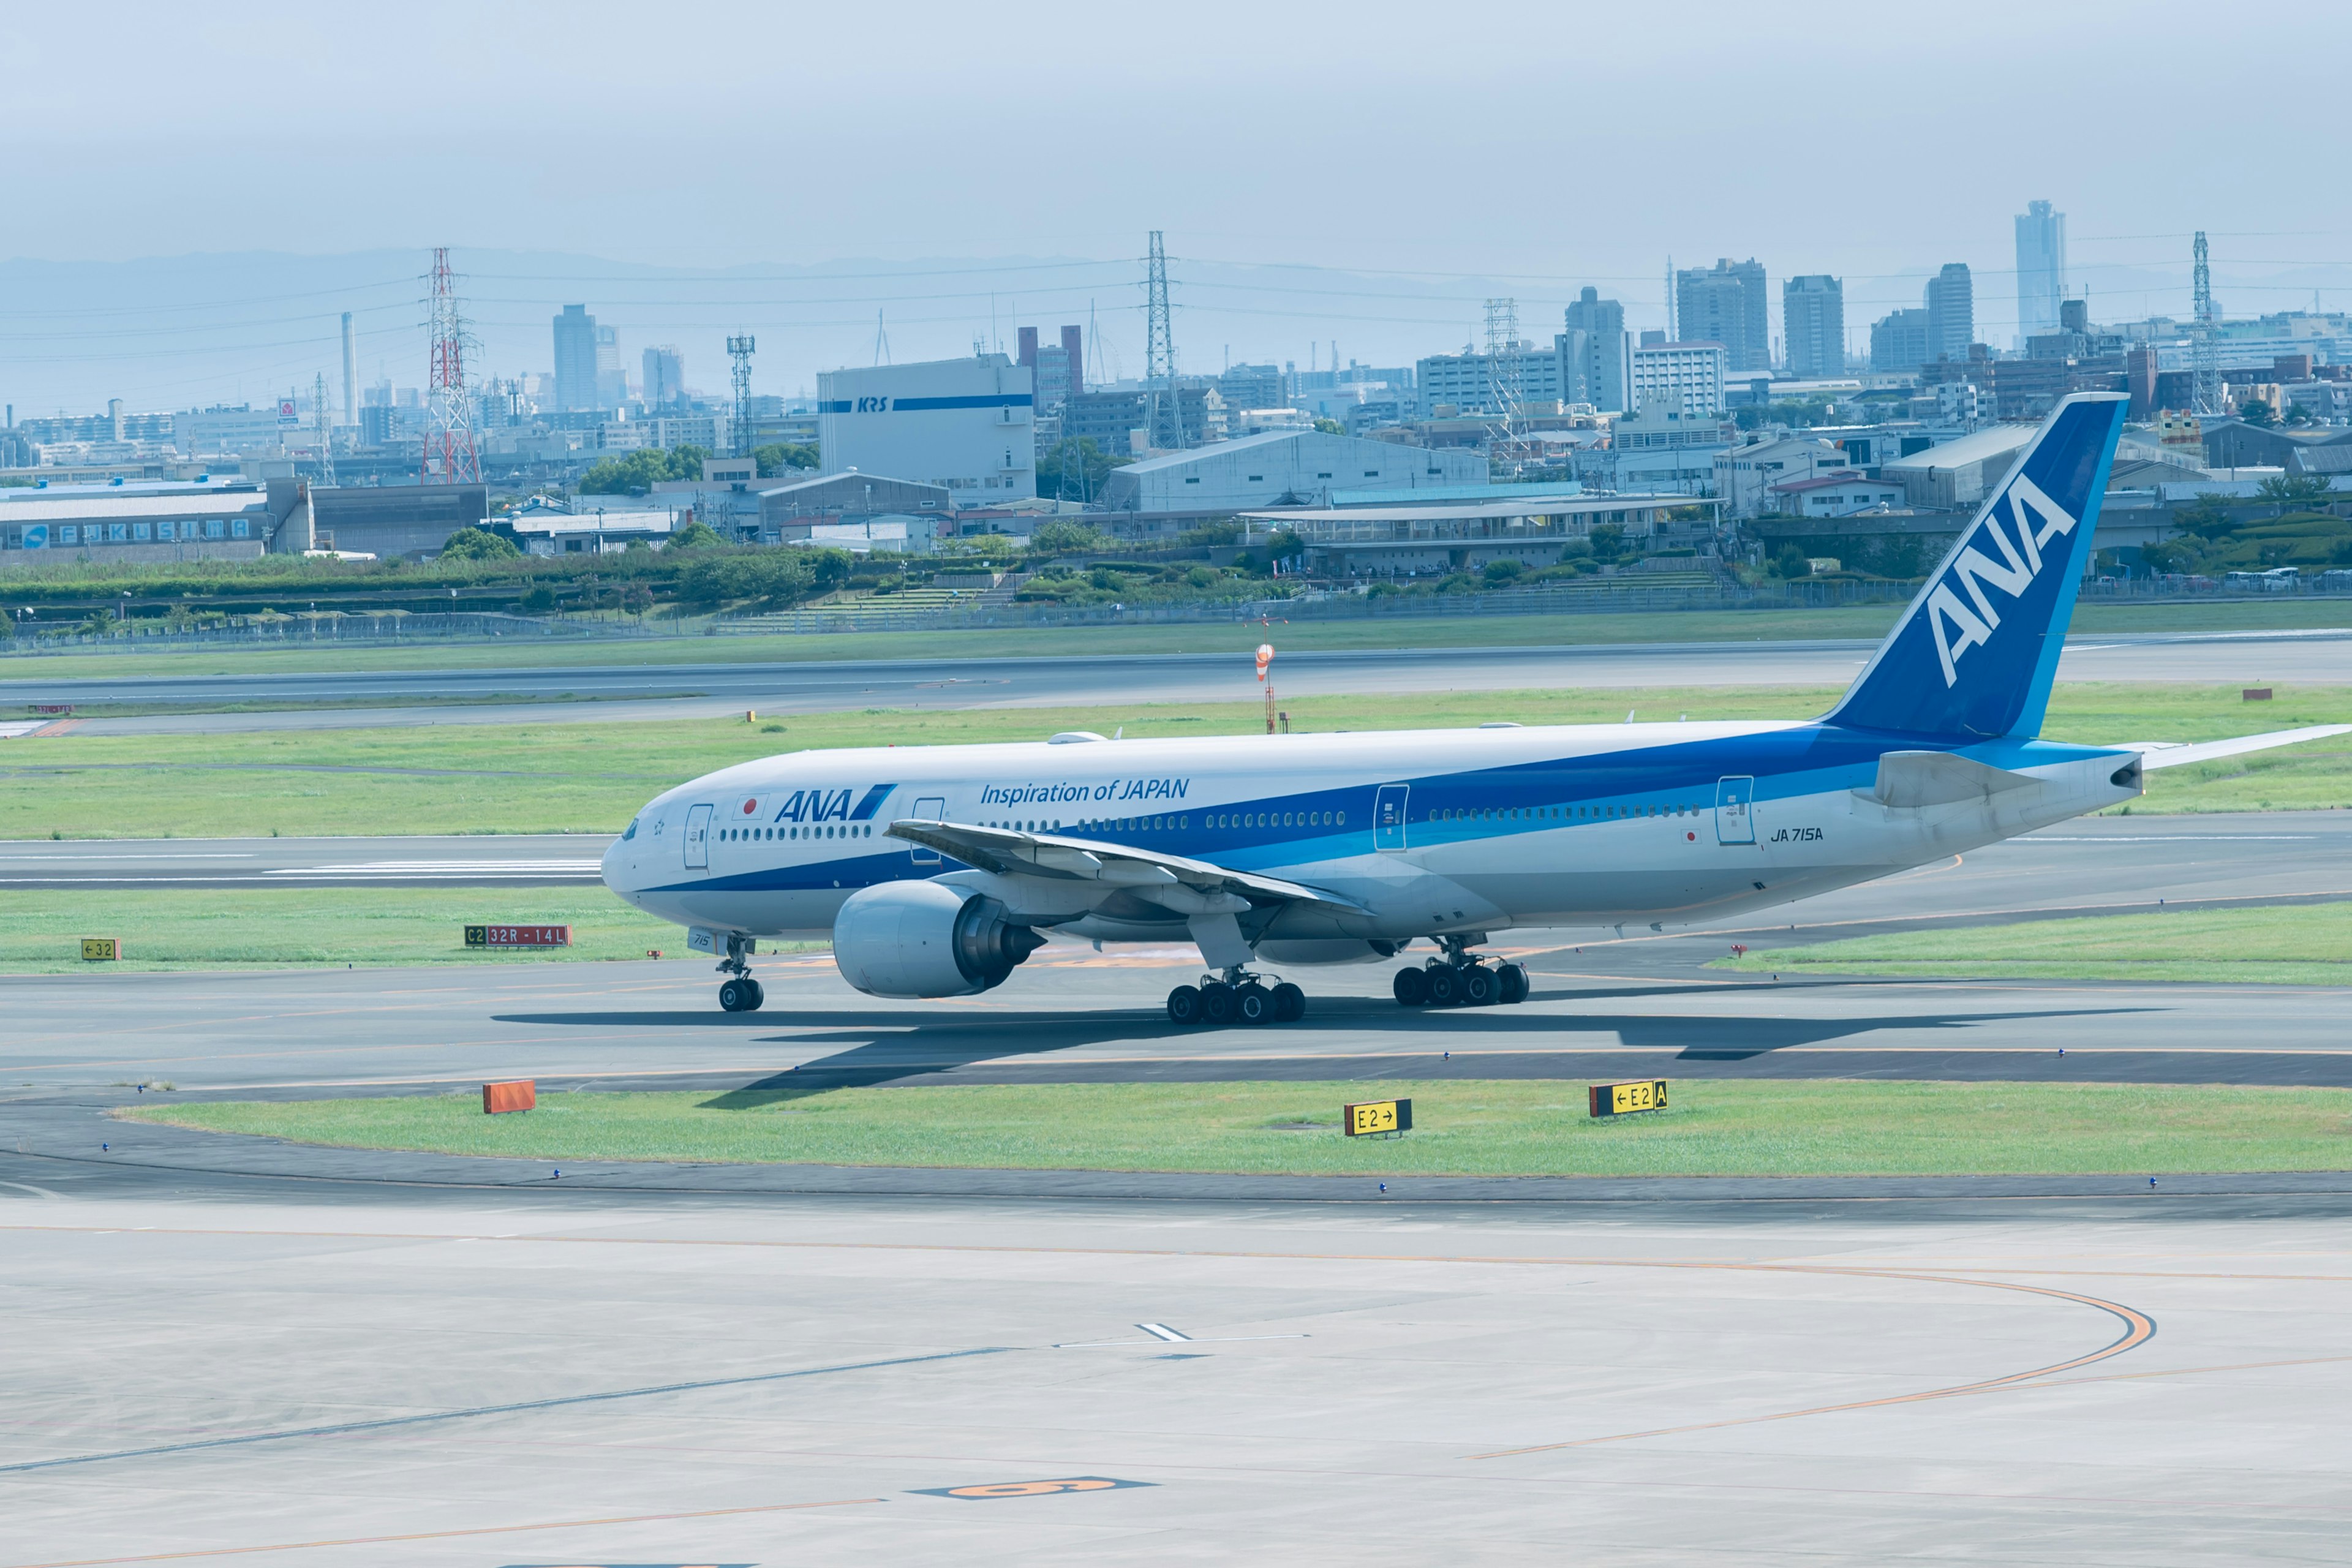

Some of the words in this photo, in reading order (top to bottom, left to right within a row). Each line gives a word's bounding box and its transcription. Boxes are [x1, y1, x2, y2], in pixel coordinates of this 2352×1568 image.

[858, 397, 888, 413] KRS
[1927, 472, 2077, 689] ANA
[981, 782, 1090, 808] Inspiration
[1093, 779, 1120, 801] of
[1118, 778, 1190, 800] JAPAN
[774, 789, 853, 823] ANA
[467, 929, 483, 942] C2
[694, 933, 710, 946] 715
[96, 943, 111, 956] 32
[1631, 1088, 1649, 1106] E2
[1656, 1085, 1667, 1104] A
[1359, 1109, 1378, 1128] E2
